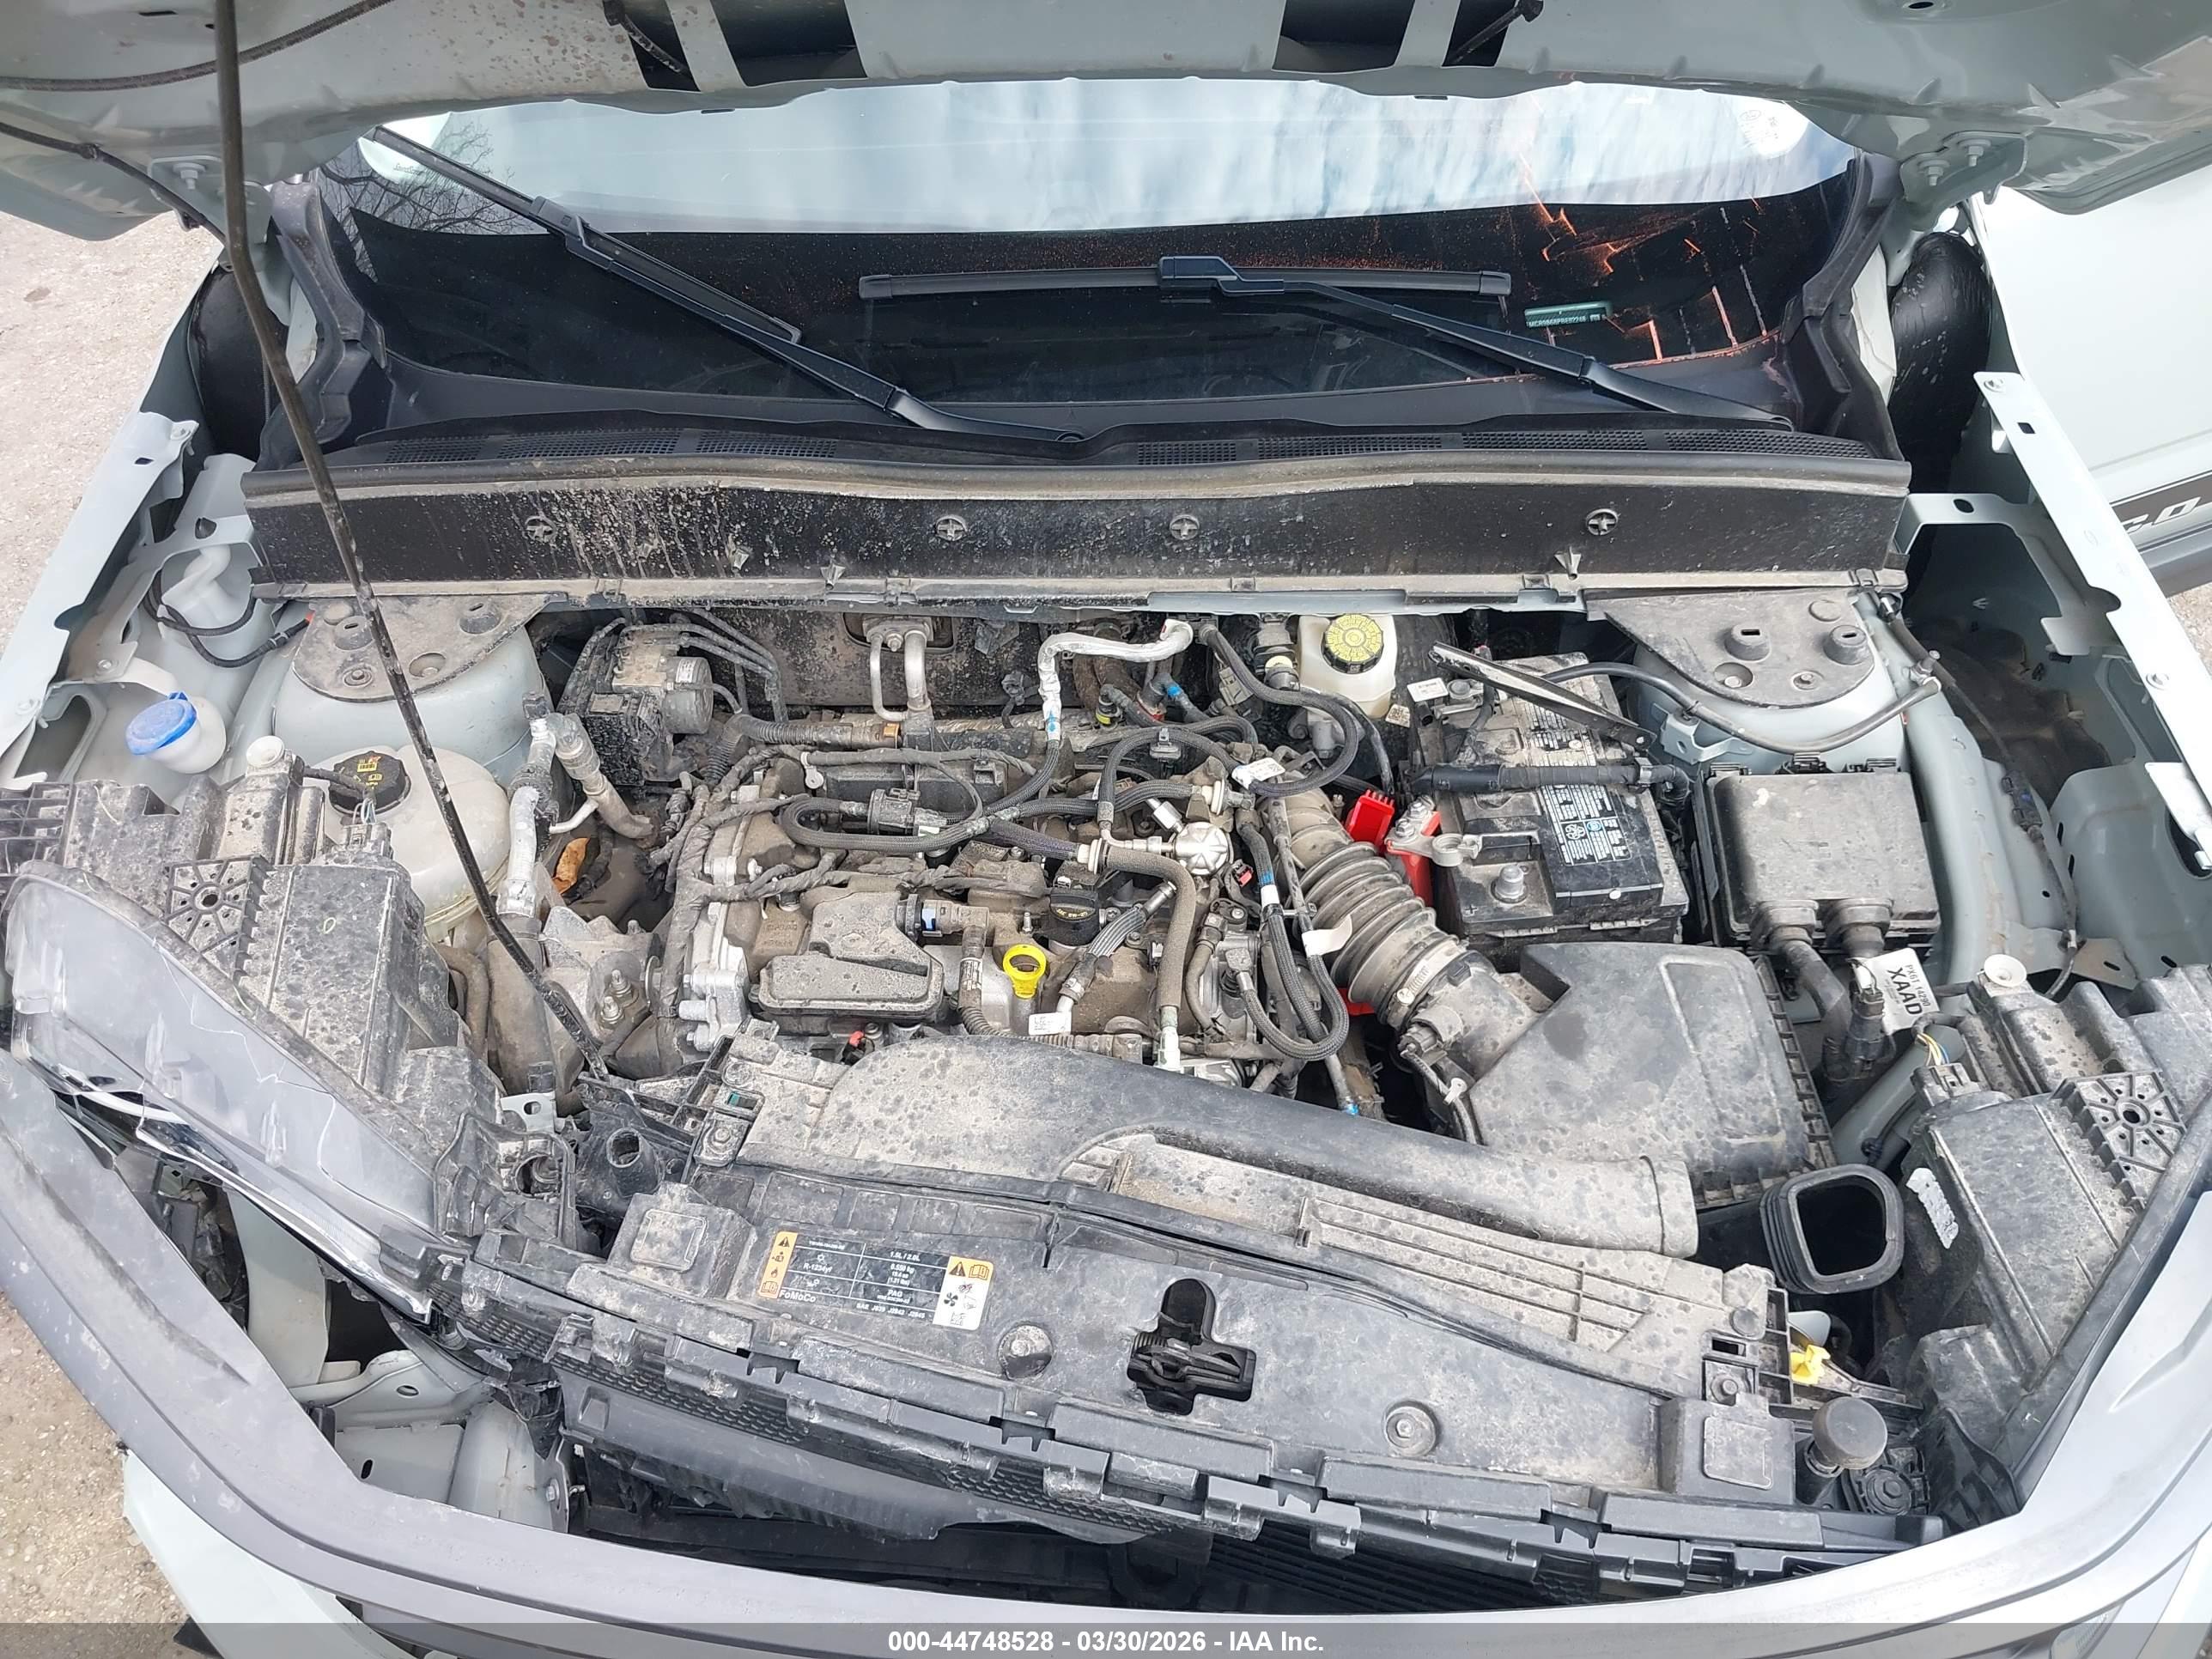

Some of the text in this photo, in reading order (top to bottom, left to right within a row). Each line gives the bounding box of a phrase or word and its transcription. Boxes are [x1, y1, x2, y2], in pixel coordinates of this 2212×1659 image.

[1887, 967, 1923, 1015] XAAD
[1915, 987, 1931, 1006] 14290
[803, 1262, 833, 1273] R-1234yf
[778, 1290, 817, 1304] FoMoCo
